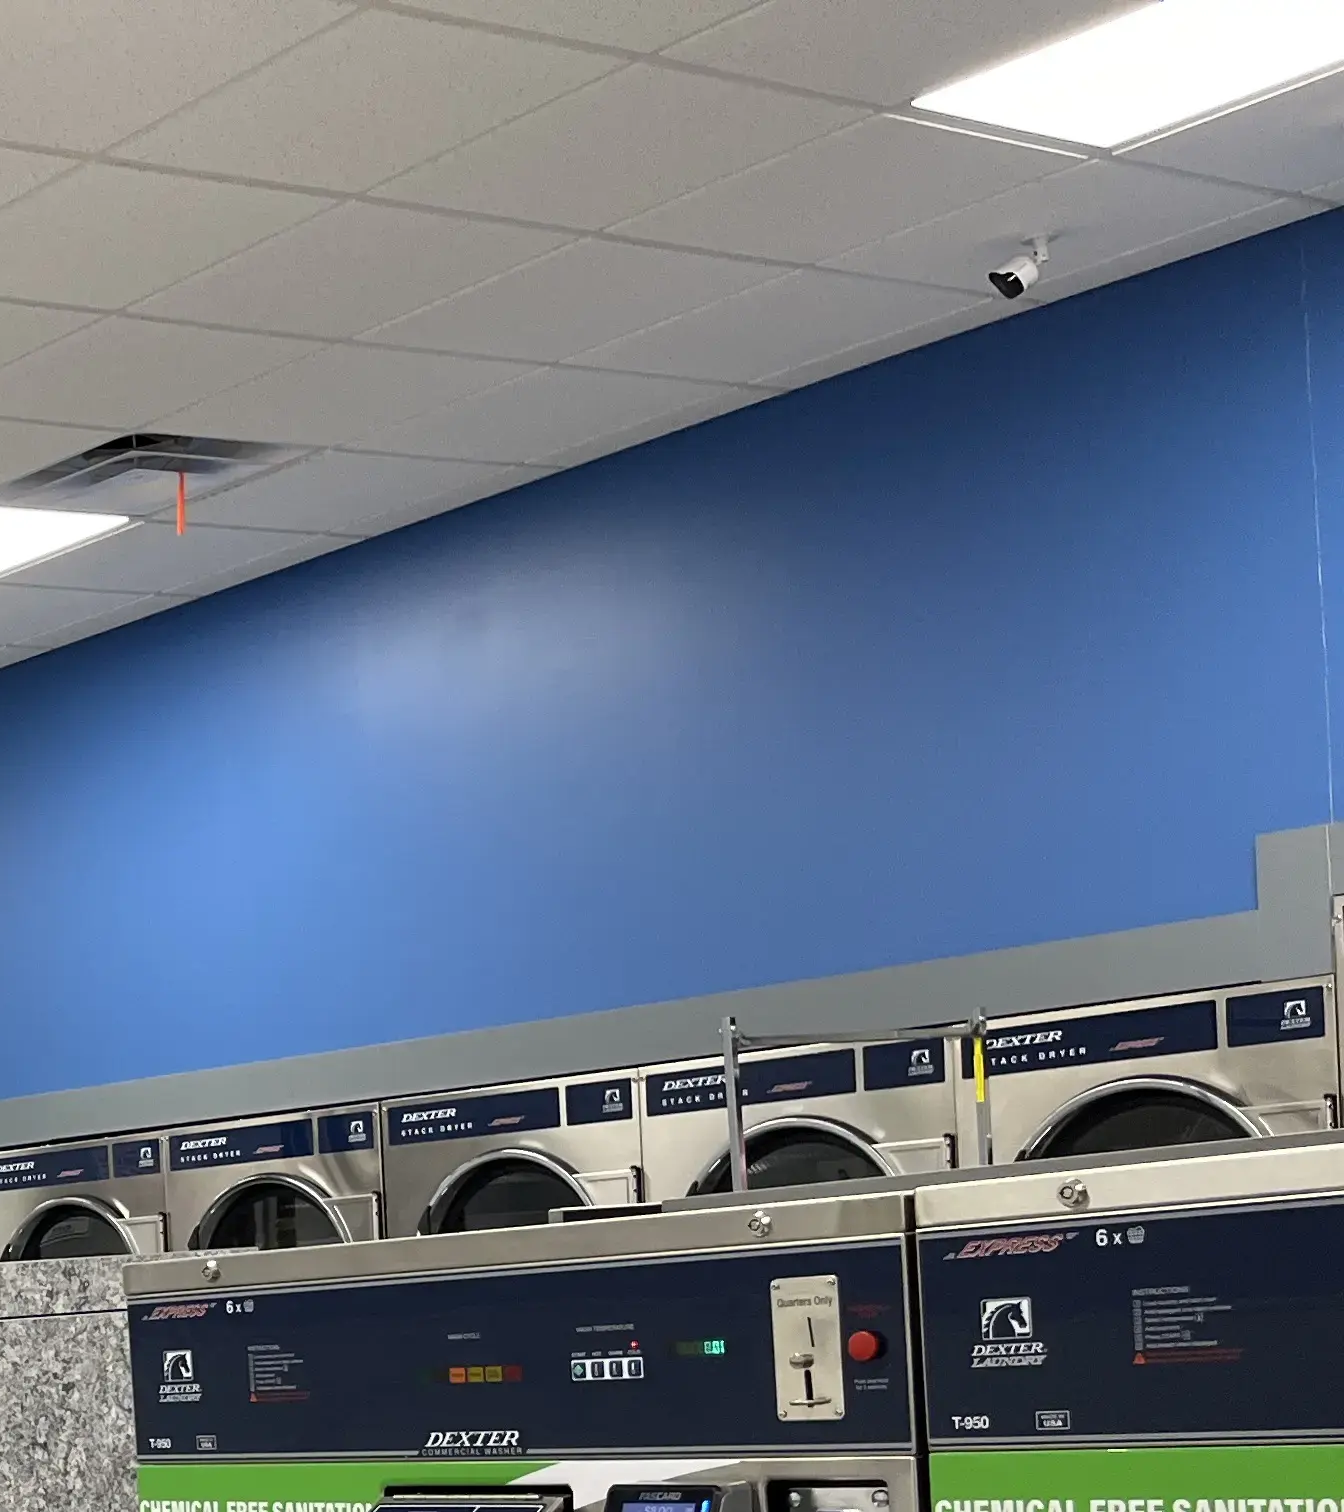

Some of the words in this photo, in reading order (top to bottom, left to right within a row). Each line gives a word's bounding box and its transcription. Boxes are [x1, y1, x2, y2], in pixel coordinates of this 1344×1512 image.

[991, 1054, 1028, 1067] TACK
[1038, 1047, 1087, 1061] DRYER
[708, 1088, 749, 1102] DRR
[401, 1107, 457, 1123] DEXTER
[180, 1136, 227, 1151] DEXTER
[1095, 1228, 1108, 1247] 6
[1112, 1233, 1122, 1246] x
[957, 1234, 1064, 1260] EXPRESS
[225, 1300, 234, 1314] 6
[235, 1304, 242, 1313] x
[776, 1297, 812, 1308] Quarters
[814, 1296, 833, 1307] Only
[151, 1303, 209, 1320] EXPRESS
[971, 1341, 1045, 1357] DEXTER
[970, 1354, 1048, 1369] LAUNDRY
[159, 1383, 201, 1395] DEXTER
[951, 1416, 989, 1430] T-950
[1042, 1419, 1063, 1428] USA
[148, 1438, 172, 1449] T-950
[425, 1430, 520, 1448] DEXTER
[421, 1448, 482, 1456] COMMERCIAL
[484, 1447, 523, 1456] WASHER
